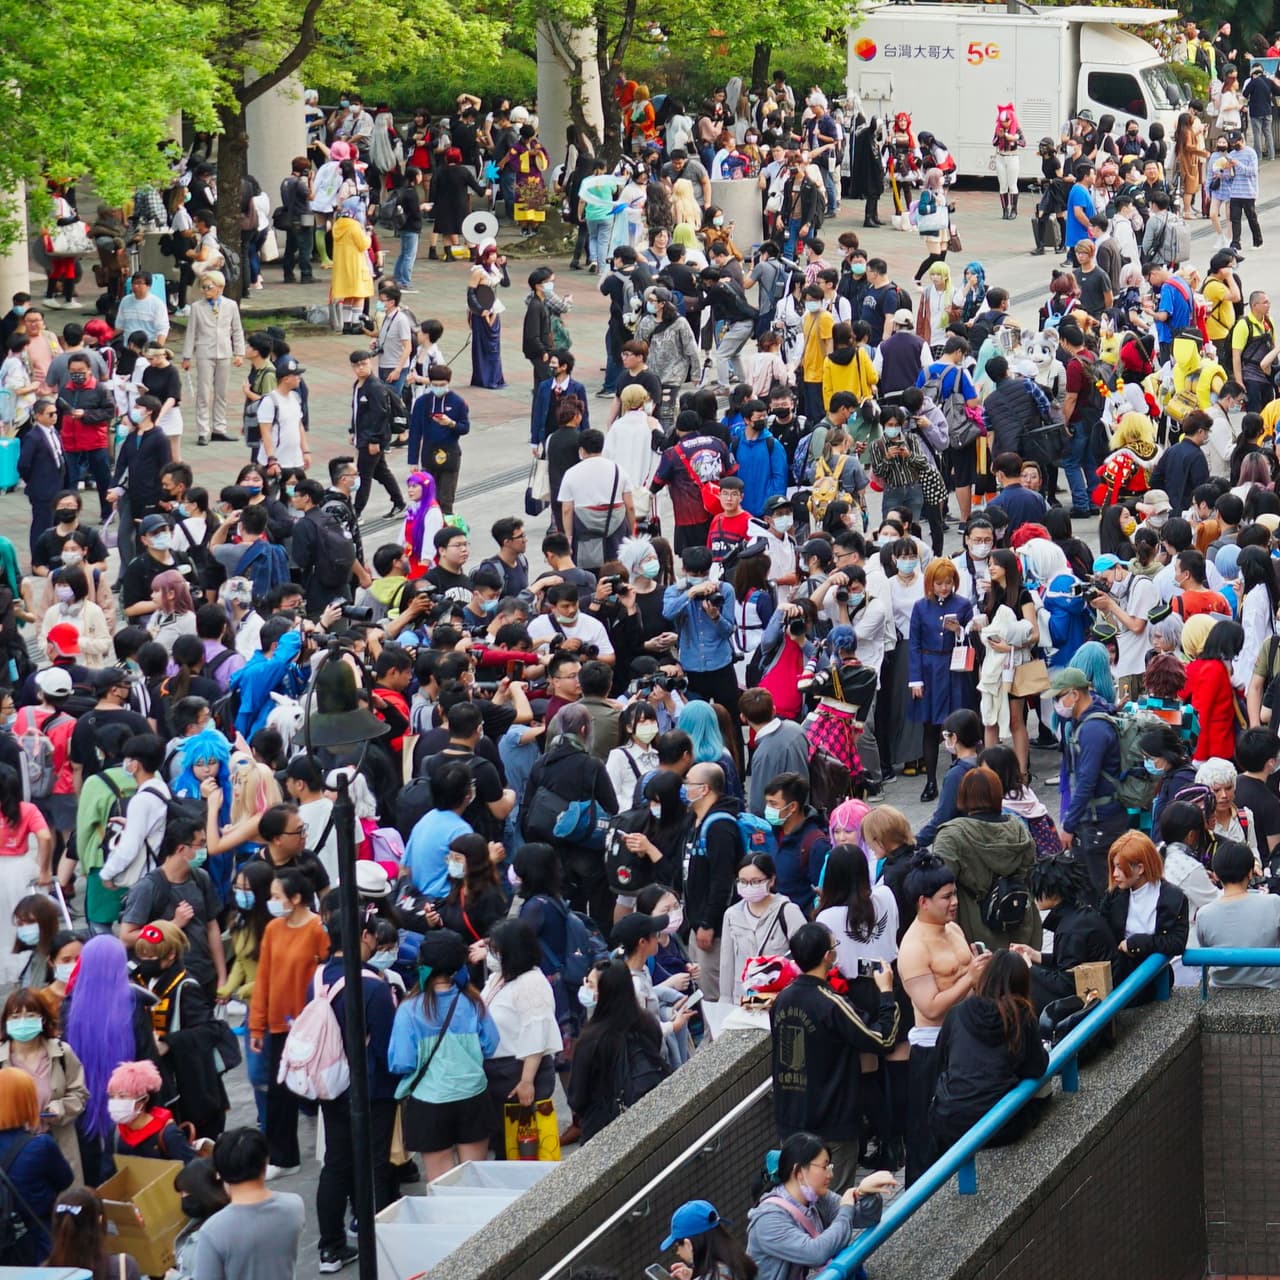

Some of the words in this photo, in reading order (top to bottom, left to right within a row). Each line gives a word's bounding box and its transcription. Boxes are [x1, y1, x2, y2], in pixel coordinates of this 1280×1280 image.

[884, 43, 955, 60] 台灣大哥大
[967, 41, 1000, 66] 5G
